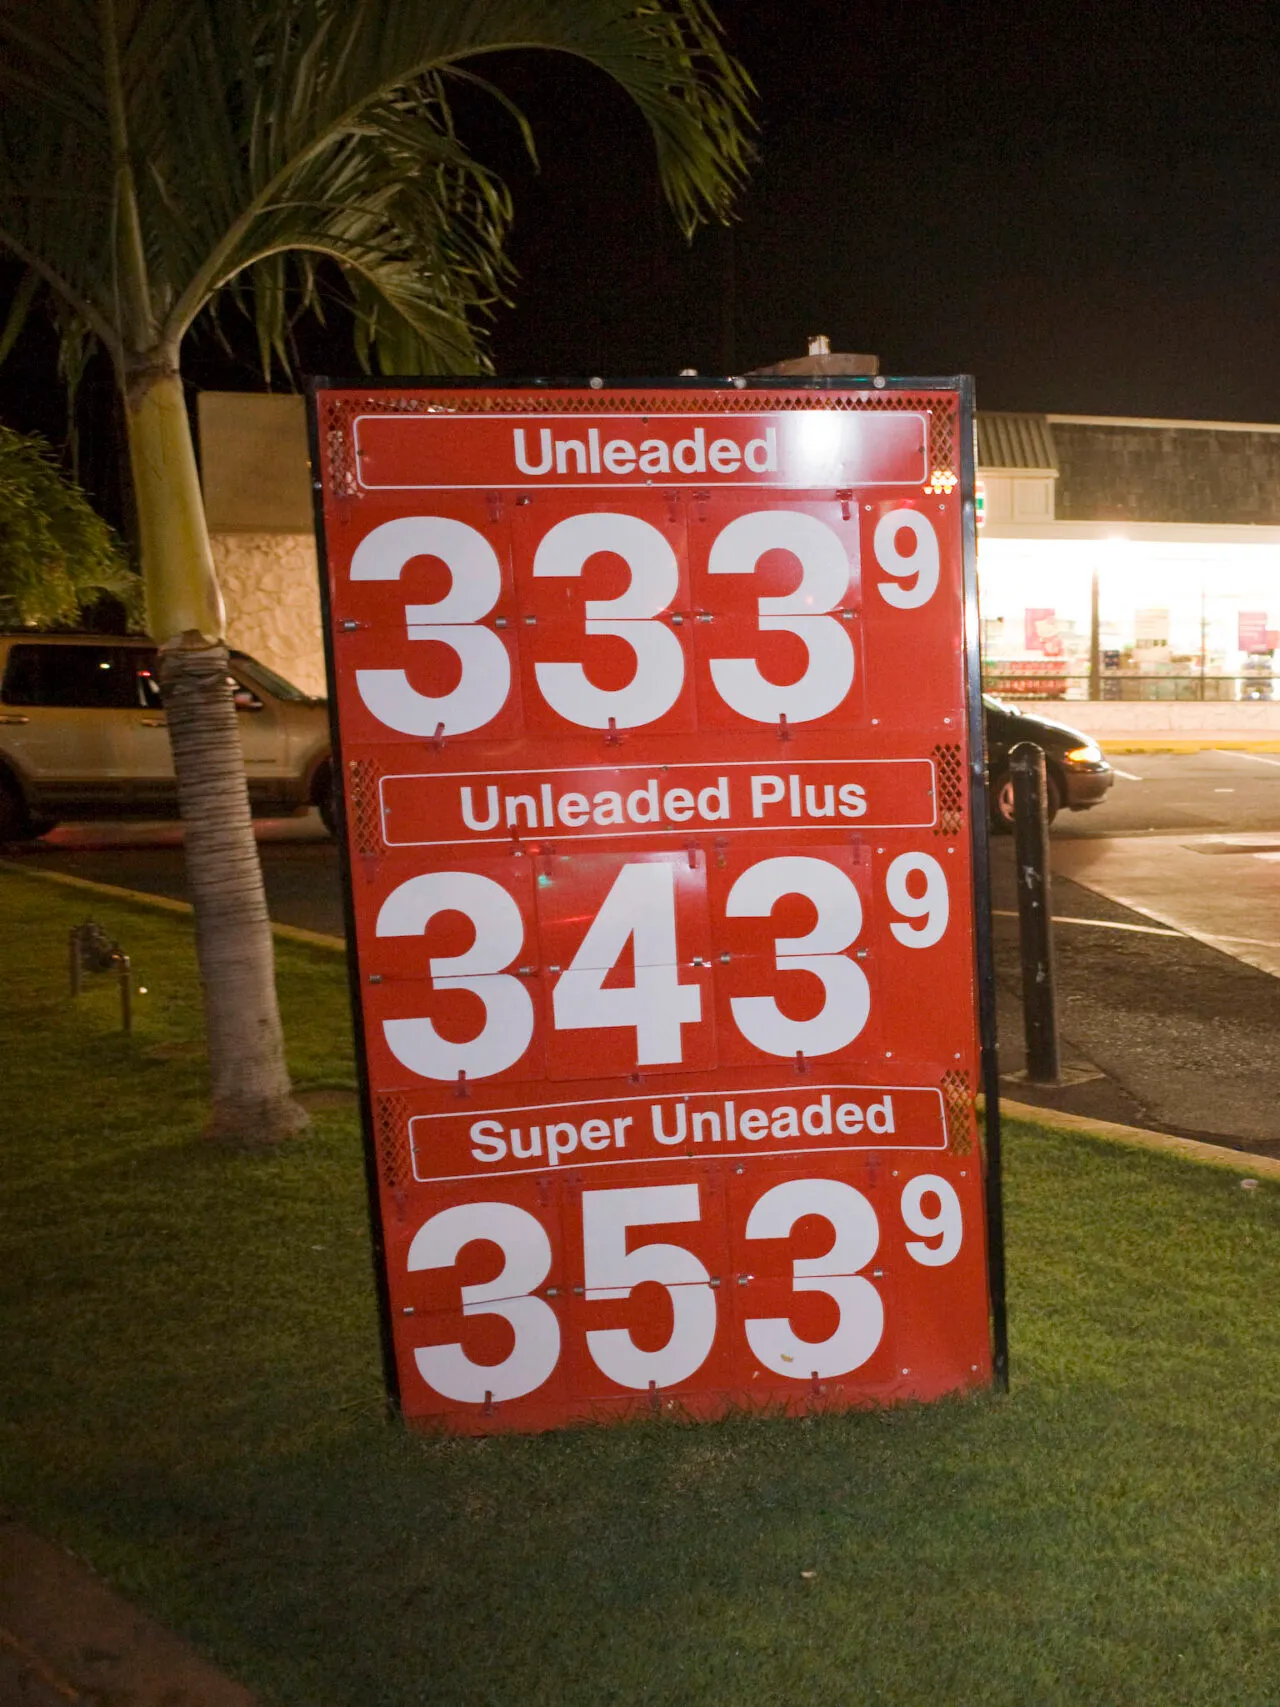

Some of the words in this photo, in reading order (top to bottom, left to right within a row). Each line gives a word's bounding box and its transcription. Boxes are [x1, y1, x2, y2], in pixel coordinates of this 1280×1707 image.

[513, 427, 777, 475] Unleaded
[460, 777, 731, 832] Unleaded
[750, 774, 867, 819] Plus
[470, 1116, 634, 1166] Super
[651, 1095, 896, 1145] Unleaded
